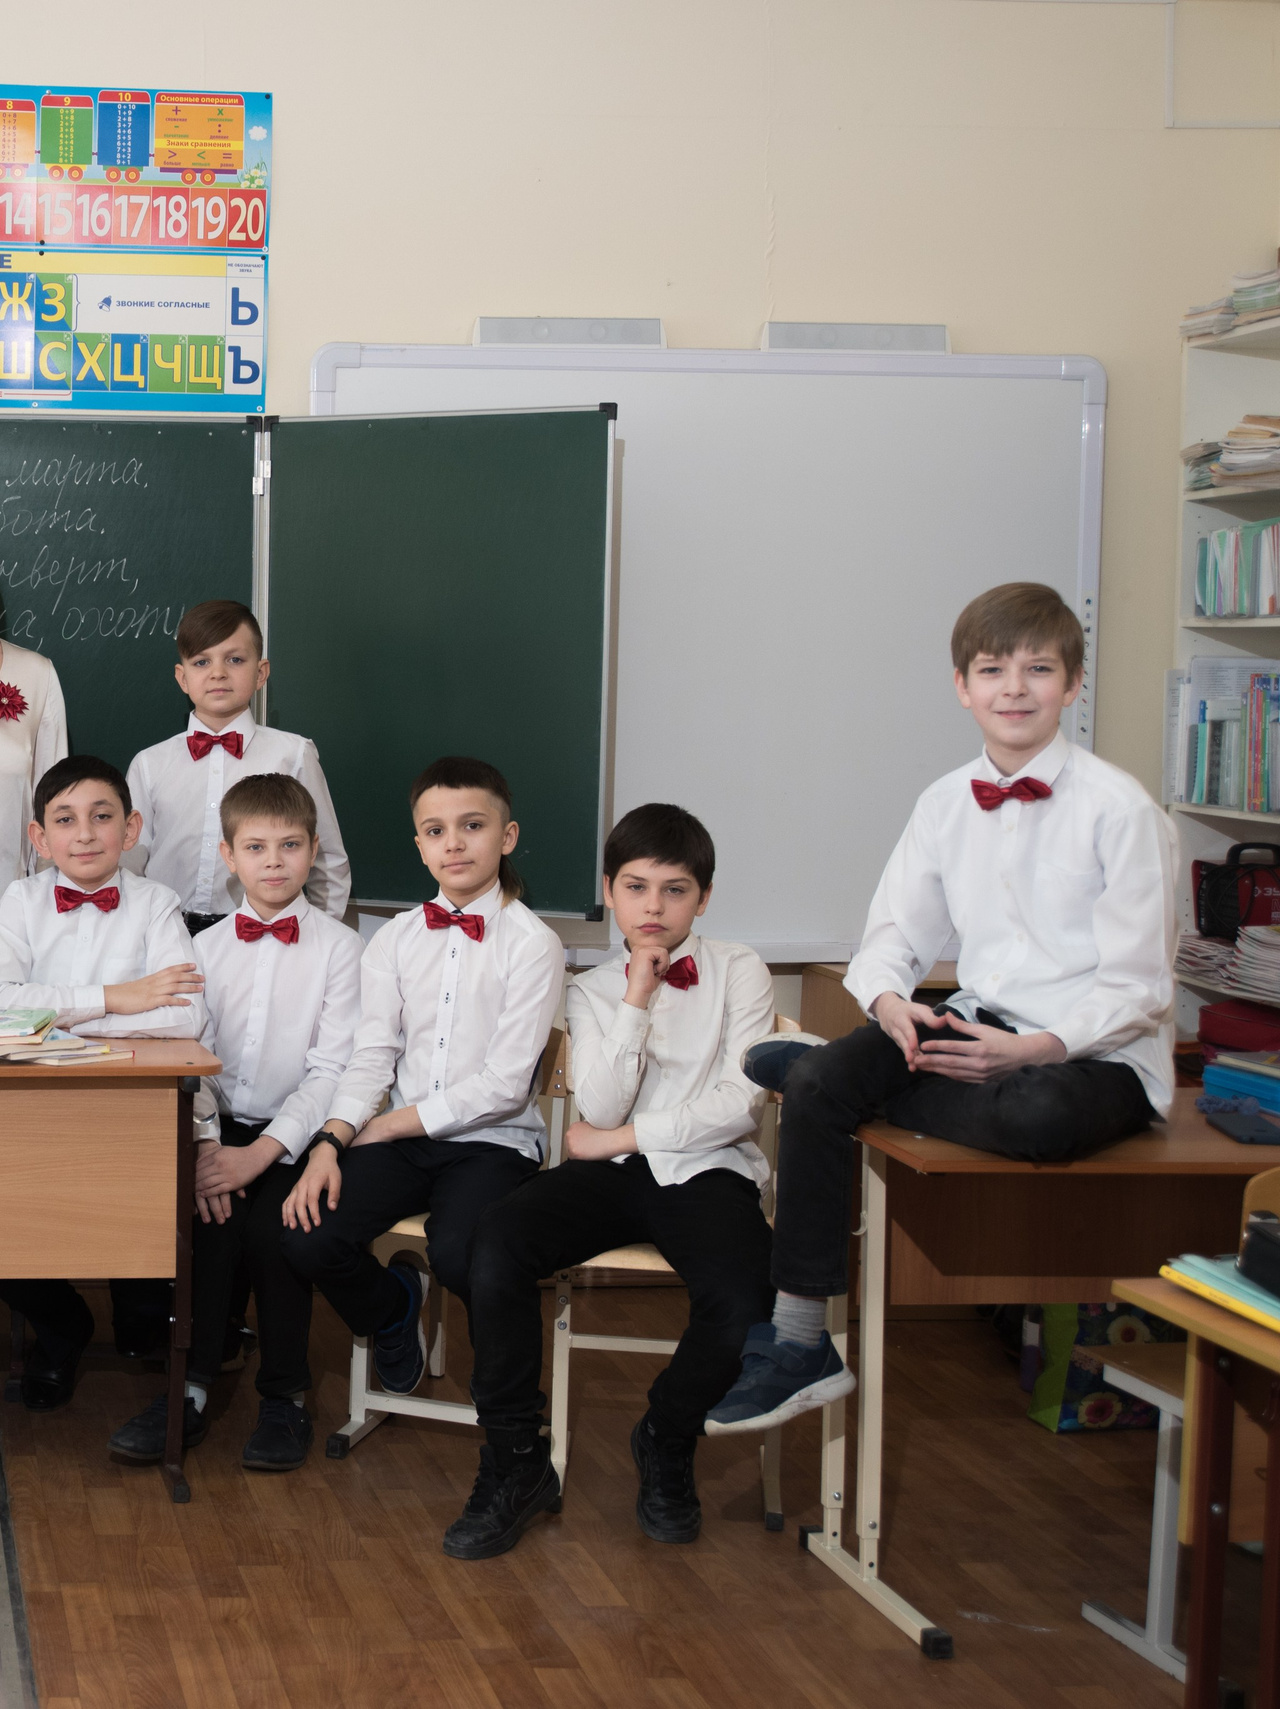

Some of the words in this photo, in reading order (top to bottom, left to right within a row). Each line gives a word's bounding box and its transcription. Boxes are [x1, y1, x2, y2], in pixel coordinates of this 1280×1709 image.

[63, 96, 71, 106] 9
[118, 92, 131, 102] 10
[160, 94, 199, 103] Основные
[6, 100, 13, 110] 8
[166, 139, 189, 147] Знаки
[191, 141, 231, 149] сравнения
[0, 192, 34, 235] 14
[38, 193, 73, 236] 15
[76, 193, 112, 237] 16
[115, 195, 150, 238] 17
[153, 195, 188, 239] 18
[191, 196, 227, 239] 19
[229, 197, 265, 241] 20
[116, 300, 155, 308] ЗВОНКИЕ
[157, 301, 211, 309] СОГЛАСНЫЕ
